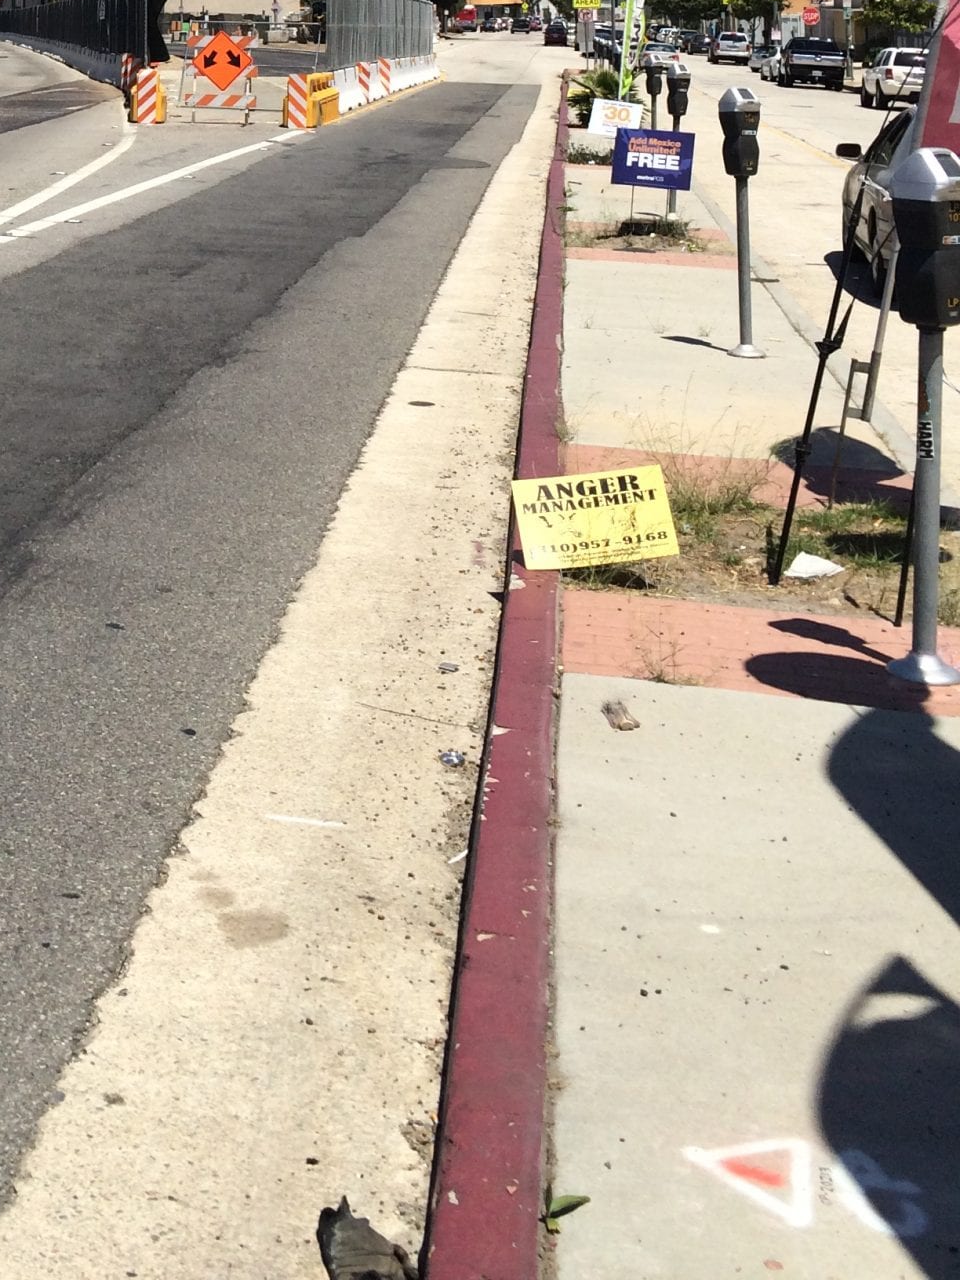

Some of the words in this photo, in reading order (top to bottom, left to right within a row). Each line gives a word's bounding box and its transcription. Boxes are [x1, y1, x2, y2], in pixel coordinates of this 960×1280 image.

[803, 12, 819, 21] STOP
[630, 137, 647, 145] Add
[649, 138, 681, 148] Mexico
[626, 152, 681, 171] FREE
[919, 421, 934, 459] HARM
[537, 474, 641, 501] ANGER
[522, 488, 657, 515] MANAGEMENT
